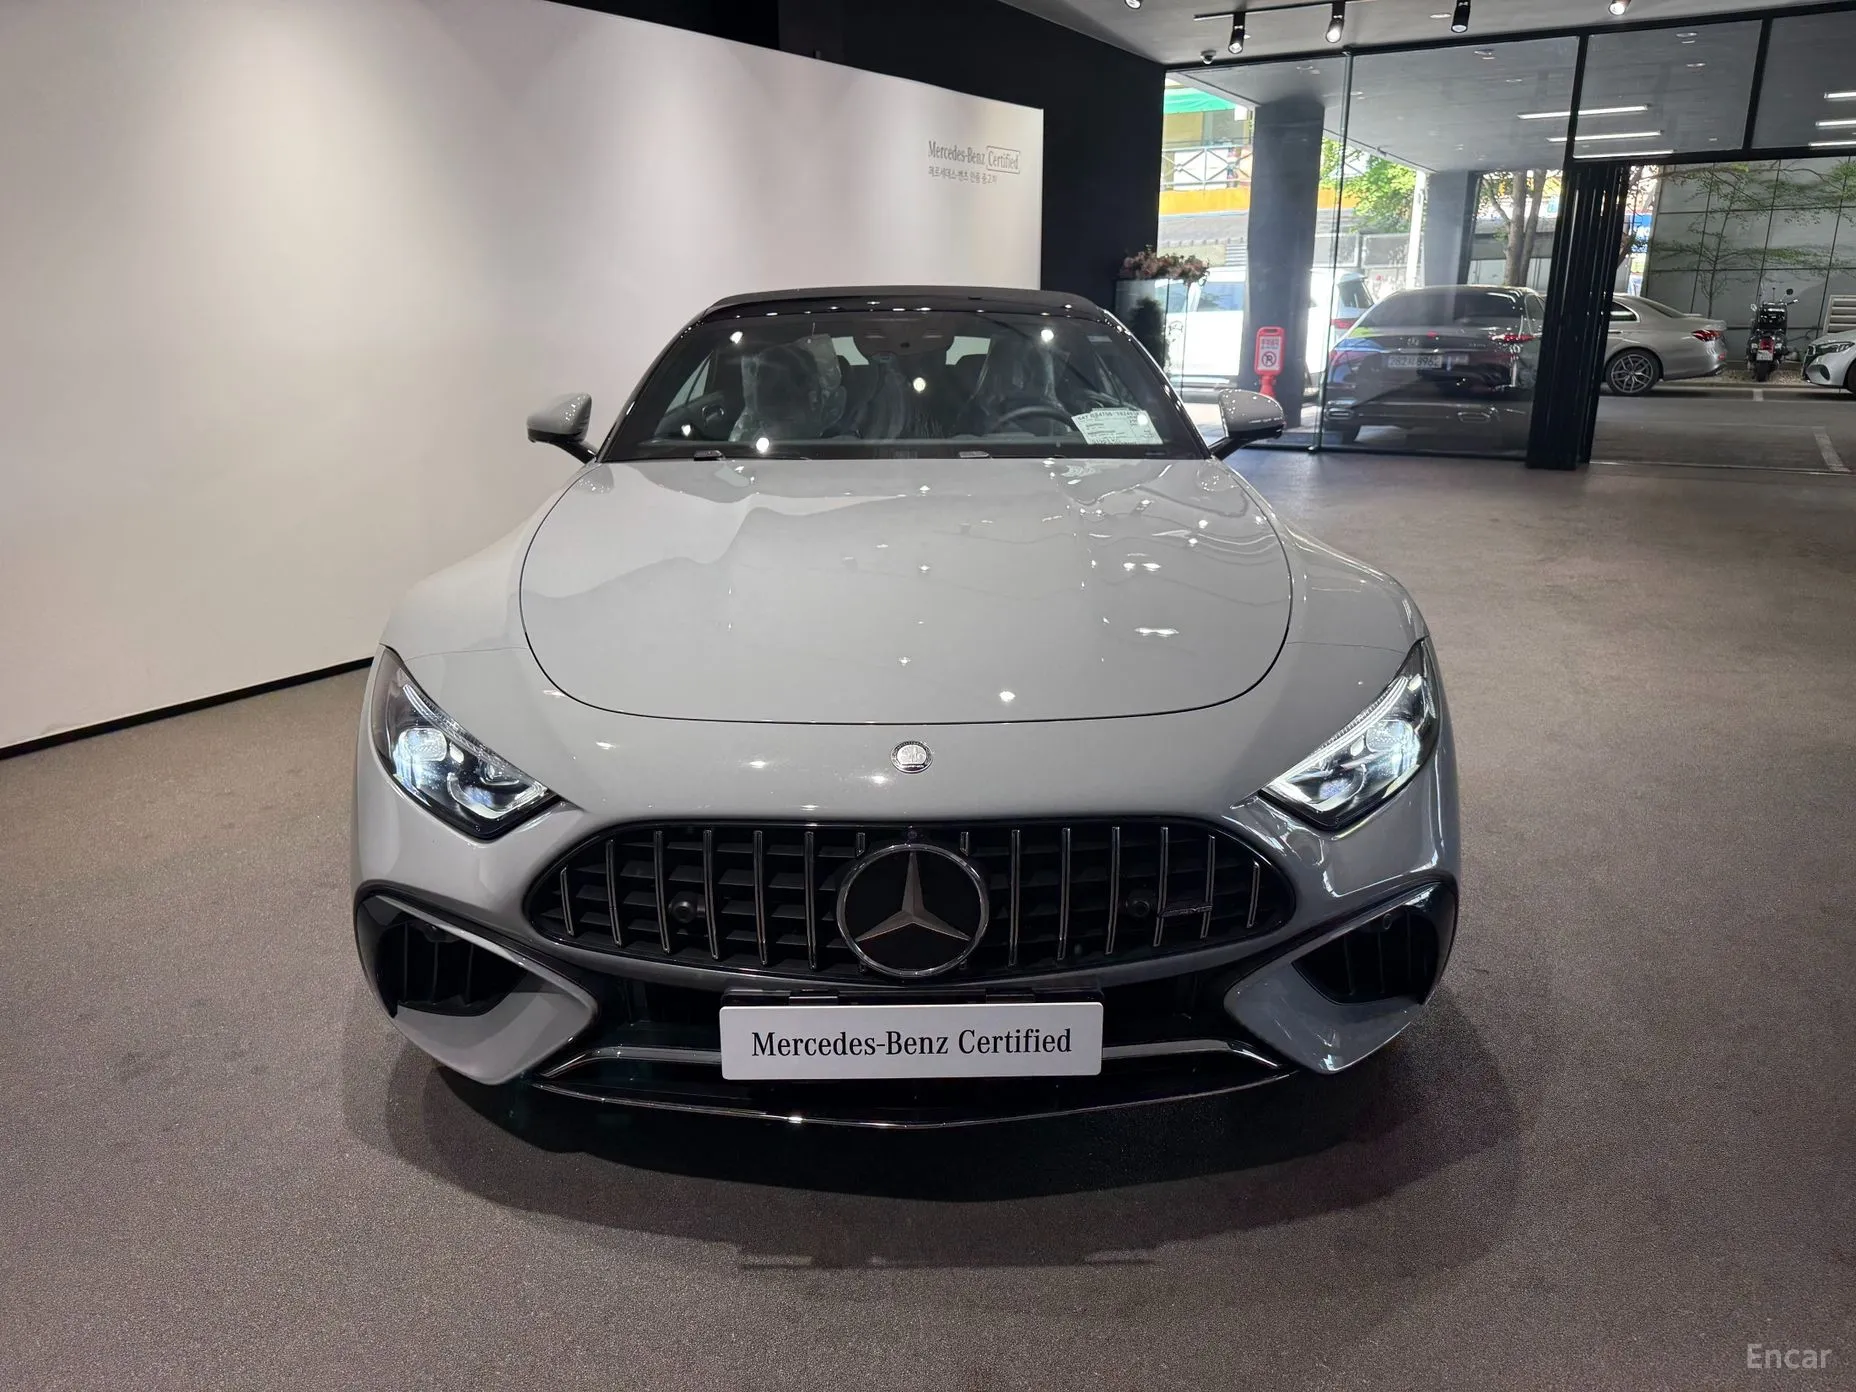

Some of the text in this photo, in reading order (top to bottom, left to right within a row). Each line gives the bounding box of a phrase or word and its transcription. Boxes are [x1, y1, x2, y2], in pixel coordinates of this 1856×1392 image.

[928, 140, 1019, 170] Mercedes-Benz Certified
[751, 1028, 1072, 1057] Mercedes-Benz Certified
